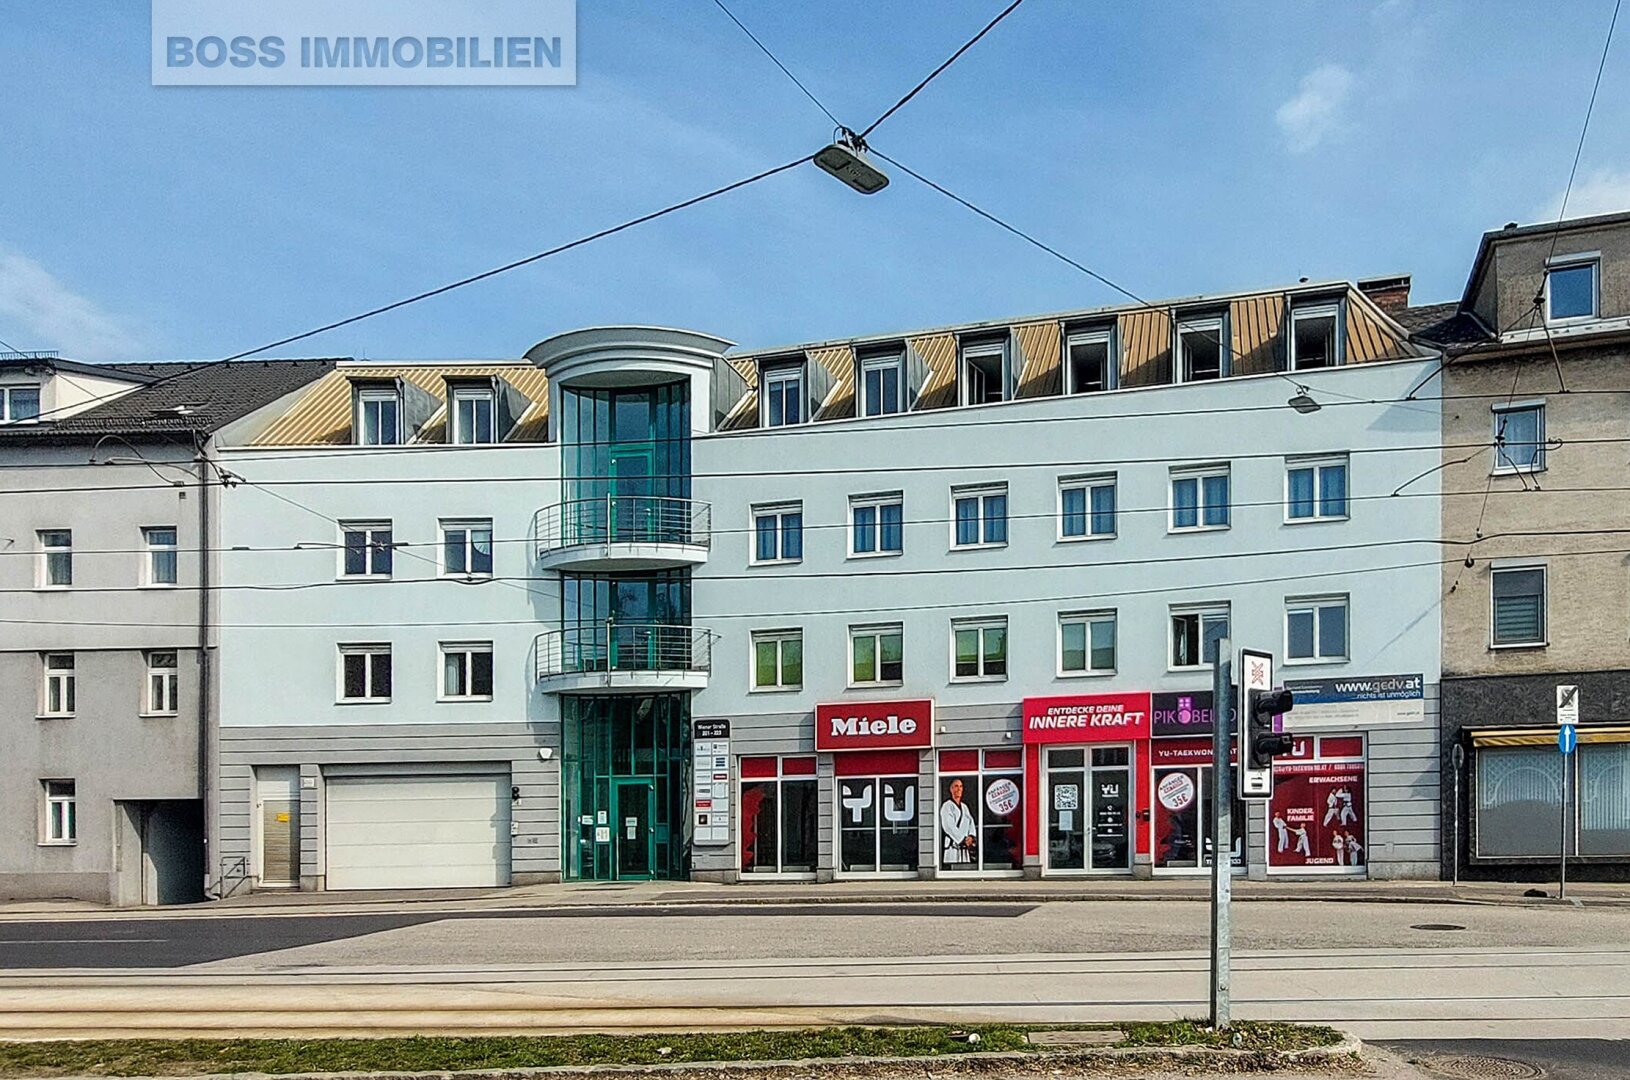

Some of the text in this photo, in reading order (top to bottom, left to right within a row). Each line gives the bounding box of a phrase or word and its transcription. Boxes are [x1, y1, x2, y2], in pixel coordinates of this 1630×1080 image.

[1335, 677, 1420, 692] www.gedv.at
[1047, 704, 1125, 716] ENTDECKE DEINE
[1153, 708, 1237, 724] PIKOBEL
[831, 715, 917, 737] Miele
[1028, 711, 1145, 730] INNERE KRAFT
[1308, 775, 1358, 784] ERWACHSENE
[842, 784, 915, 823] YU
[998, 799, 1014, 813] 35€
[1172, 793, 1188, 808] 35€
[1305, 857, 1334, 865] JUGEND
